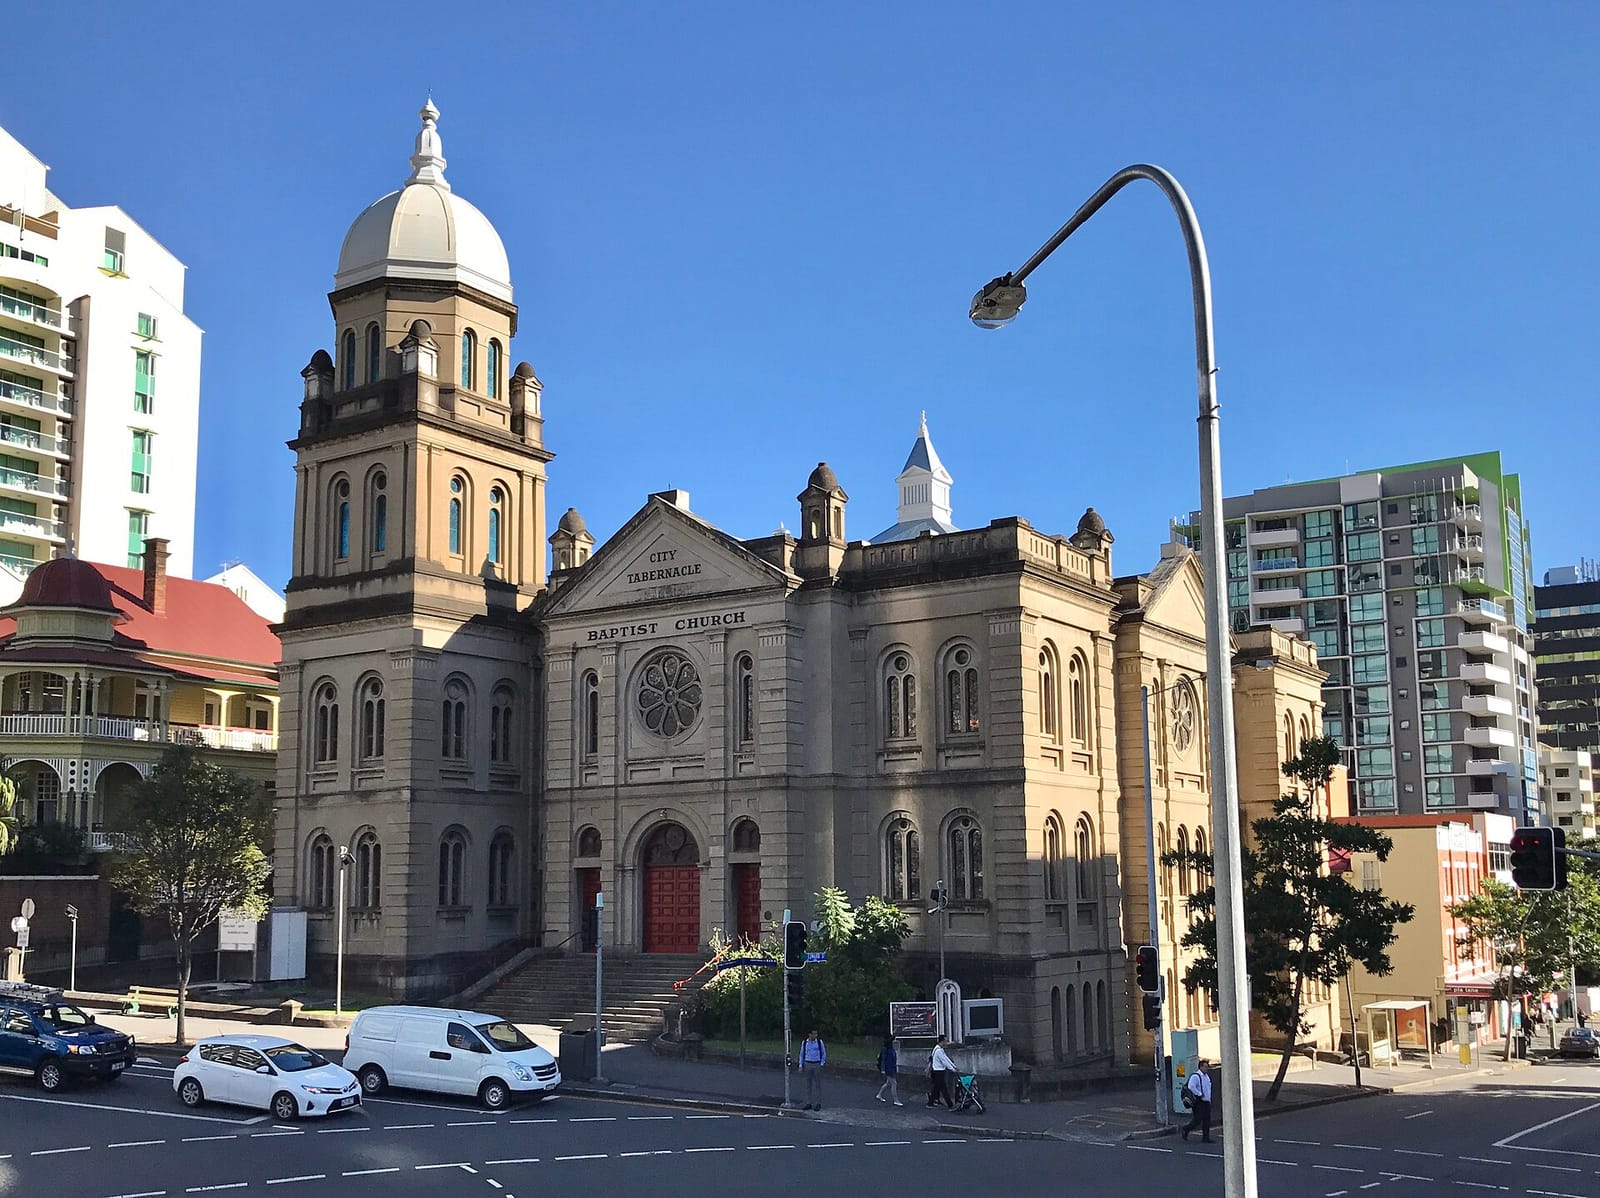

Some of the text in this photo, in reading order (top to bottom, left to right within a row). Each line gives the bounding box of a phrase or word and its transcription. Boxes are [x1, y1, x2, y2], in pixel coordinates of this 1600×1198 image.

[650, 550, 677, 563] CITY
[627, 564, 701, 584] TABERNACLE
[587, 611, 745, 641] BAPTIST CHURCH
